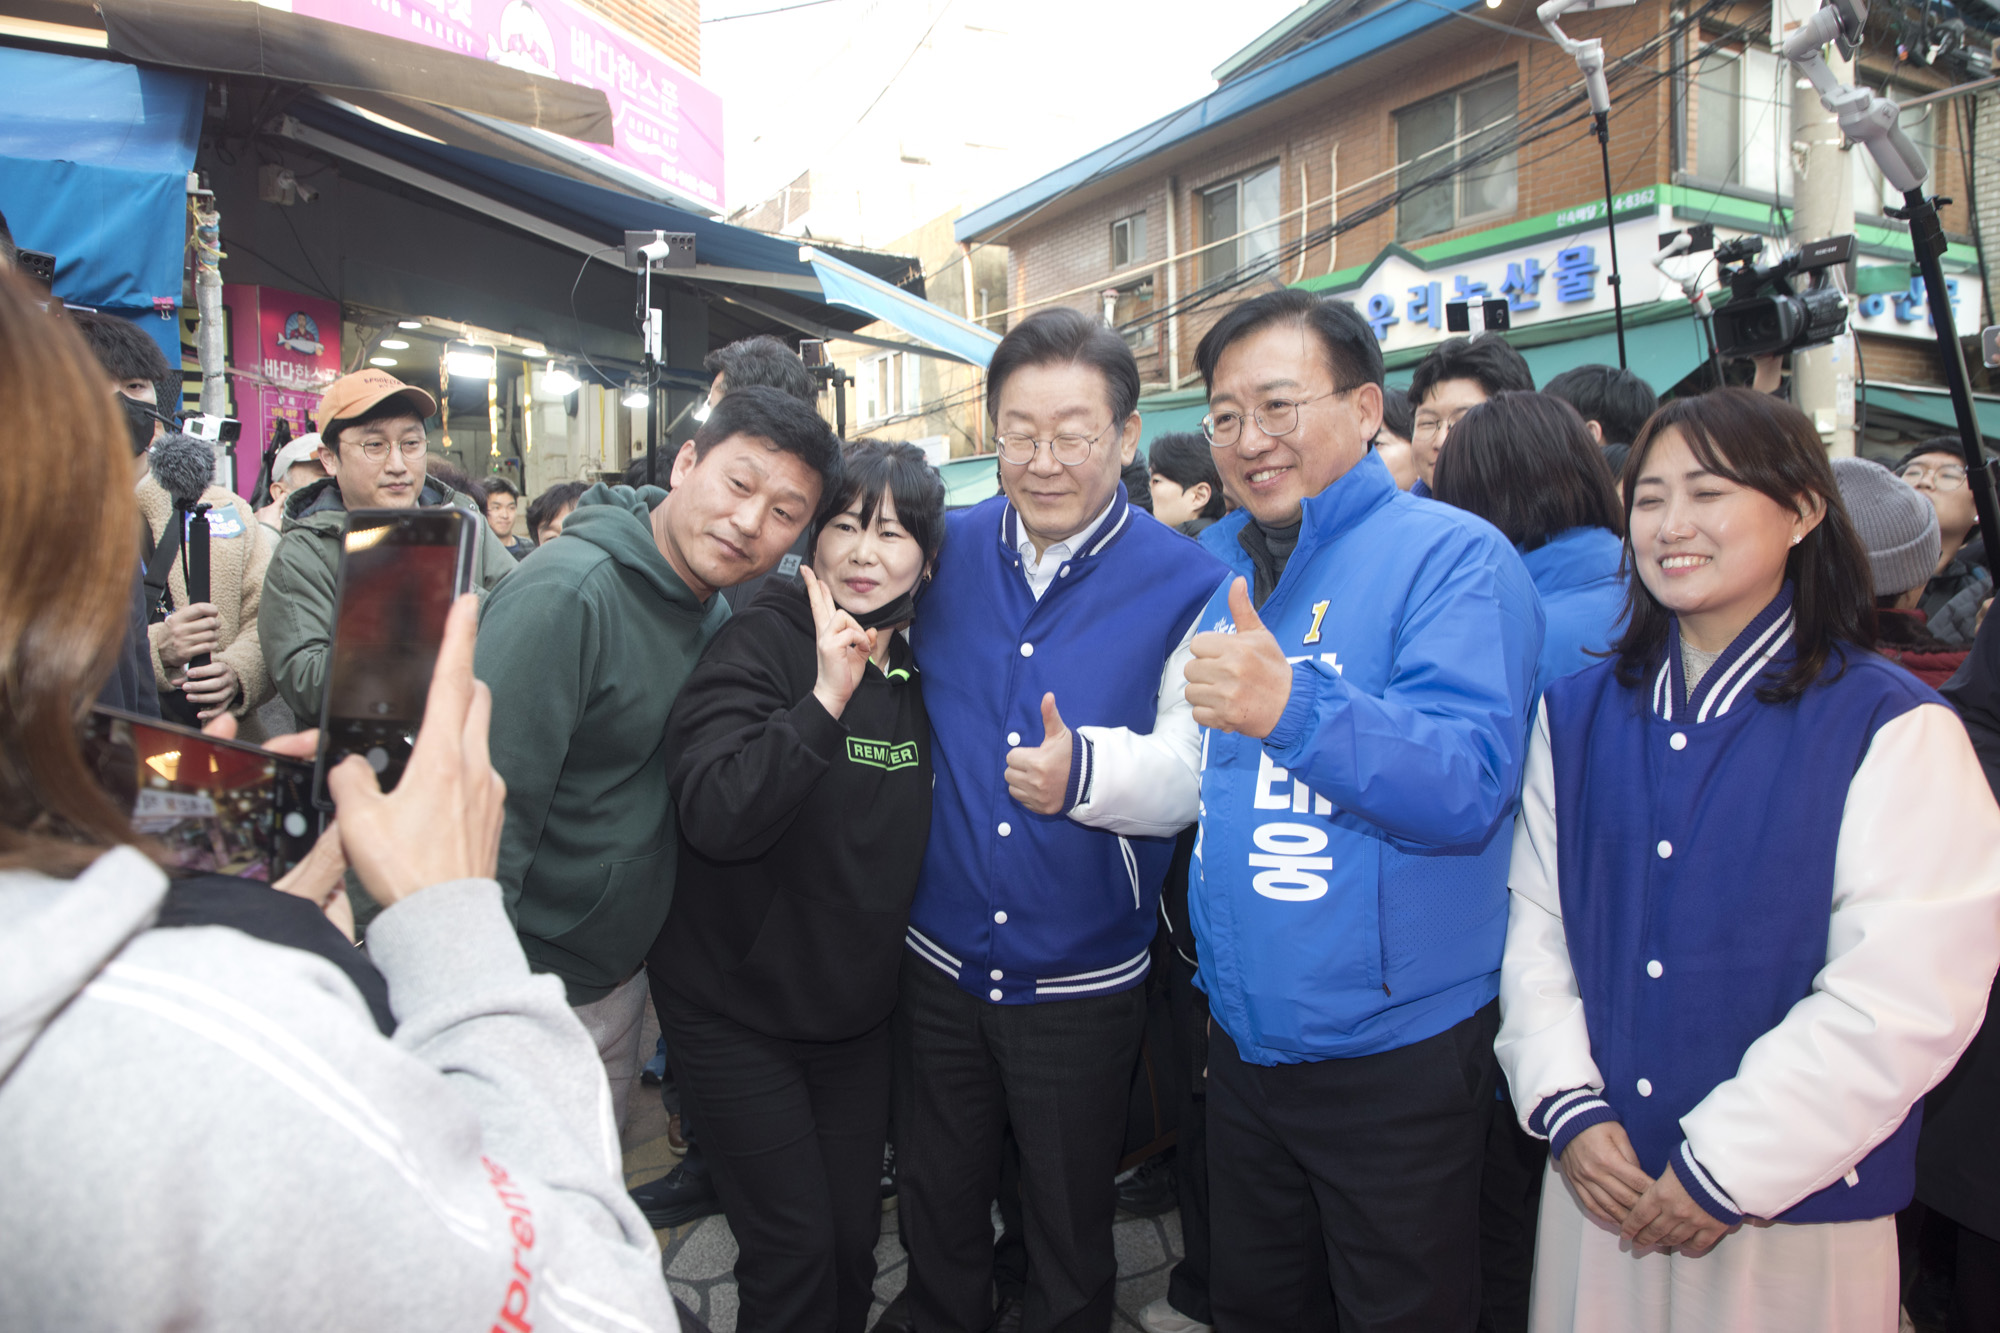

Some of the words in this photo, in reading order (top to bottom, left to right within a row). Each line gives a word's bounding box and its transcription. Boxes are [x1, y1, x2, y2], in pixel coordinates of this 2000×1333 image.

[411, 8, 473, 52] MARKET
[570, 25, 679, 121] 바다한스푼
[1601, 188, 1656, 215] 74-8362
[1302, 599, 1331, 647] 1
